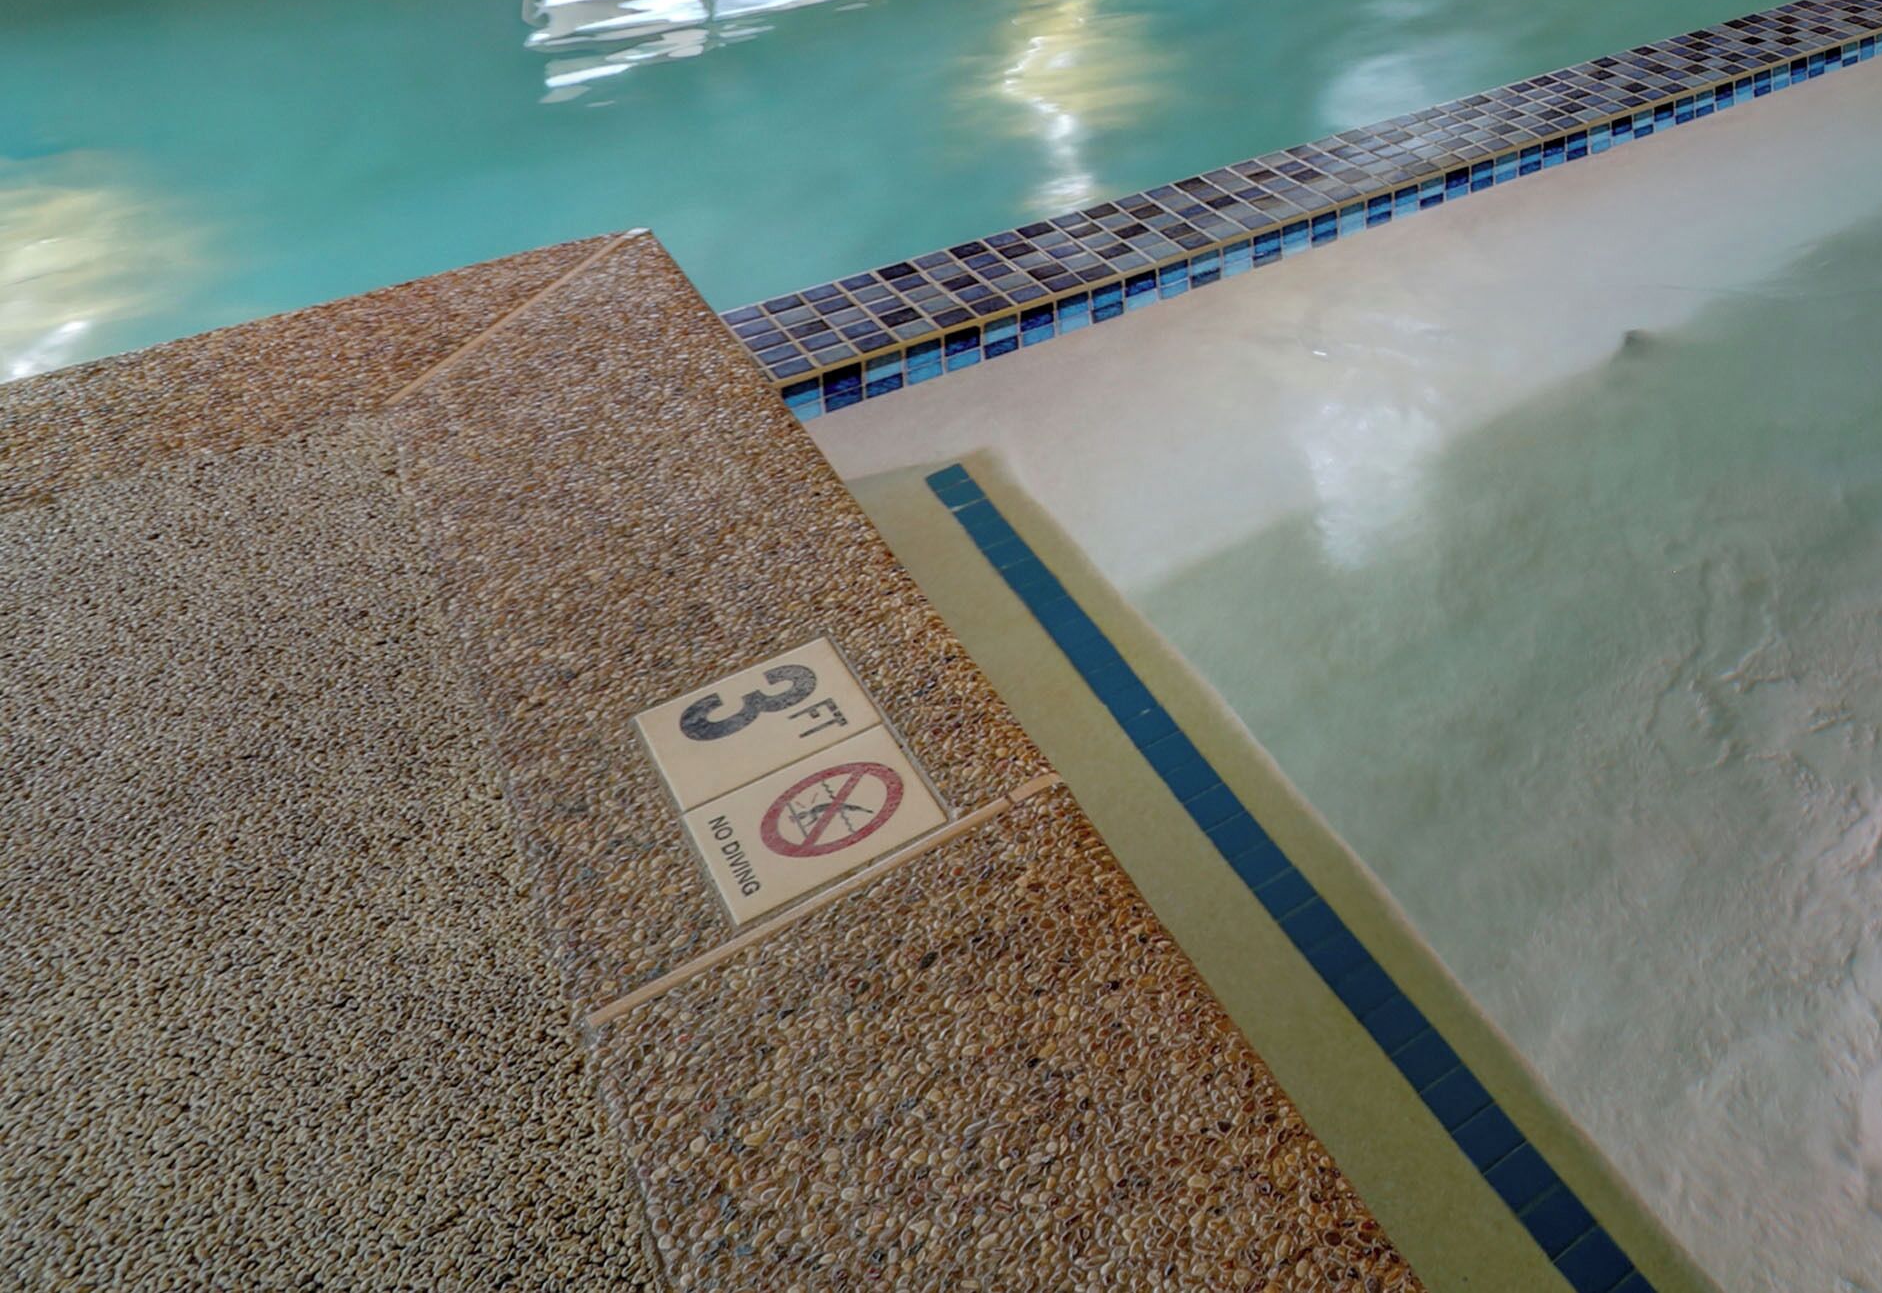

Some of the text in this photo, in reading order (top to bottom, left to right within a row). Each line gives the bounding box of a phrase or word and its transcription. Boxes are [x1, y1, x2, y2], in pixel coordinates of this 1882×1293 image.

[679, 664, 848, 741] 3 FT
[708, 815, 761, 897] NO DIVING
